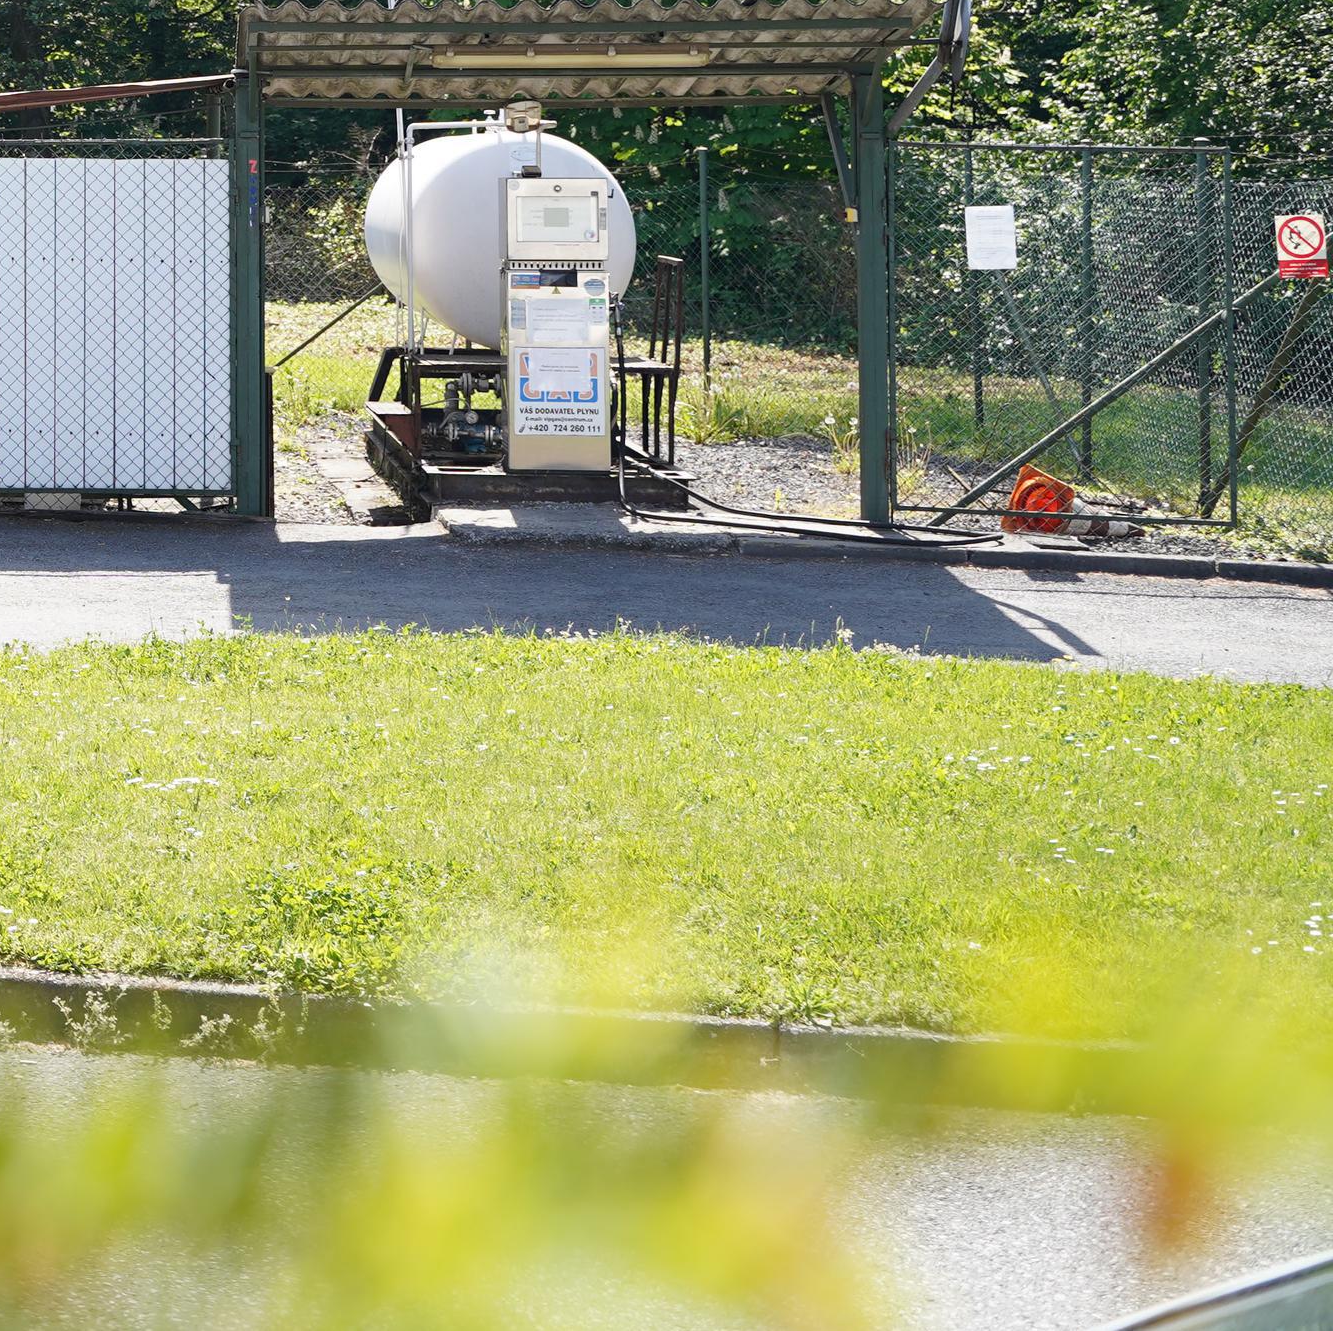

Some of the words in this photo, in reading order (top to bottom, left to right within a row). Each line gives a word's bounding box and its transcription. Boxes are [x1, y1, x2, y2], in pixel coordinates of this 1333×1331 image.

[519, 406, 533, 414] VÁŠ
[528, 424, 549, 432] +420
[553, 424, 568, 432] 724
